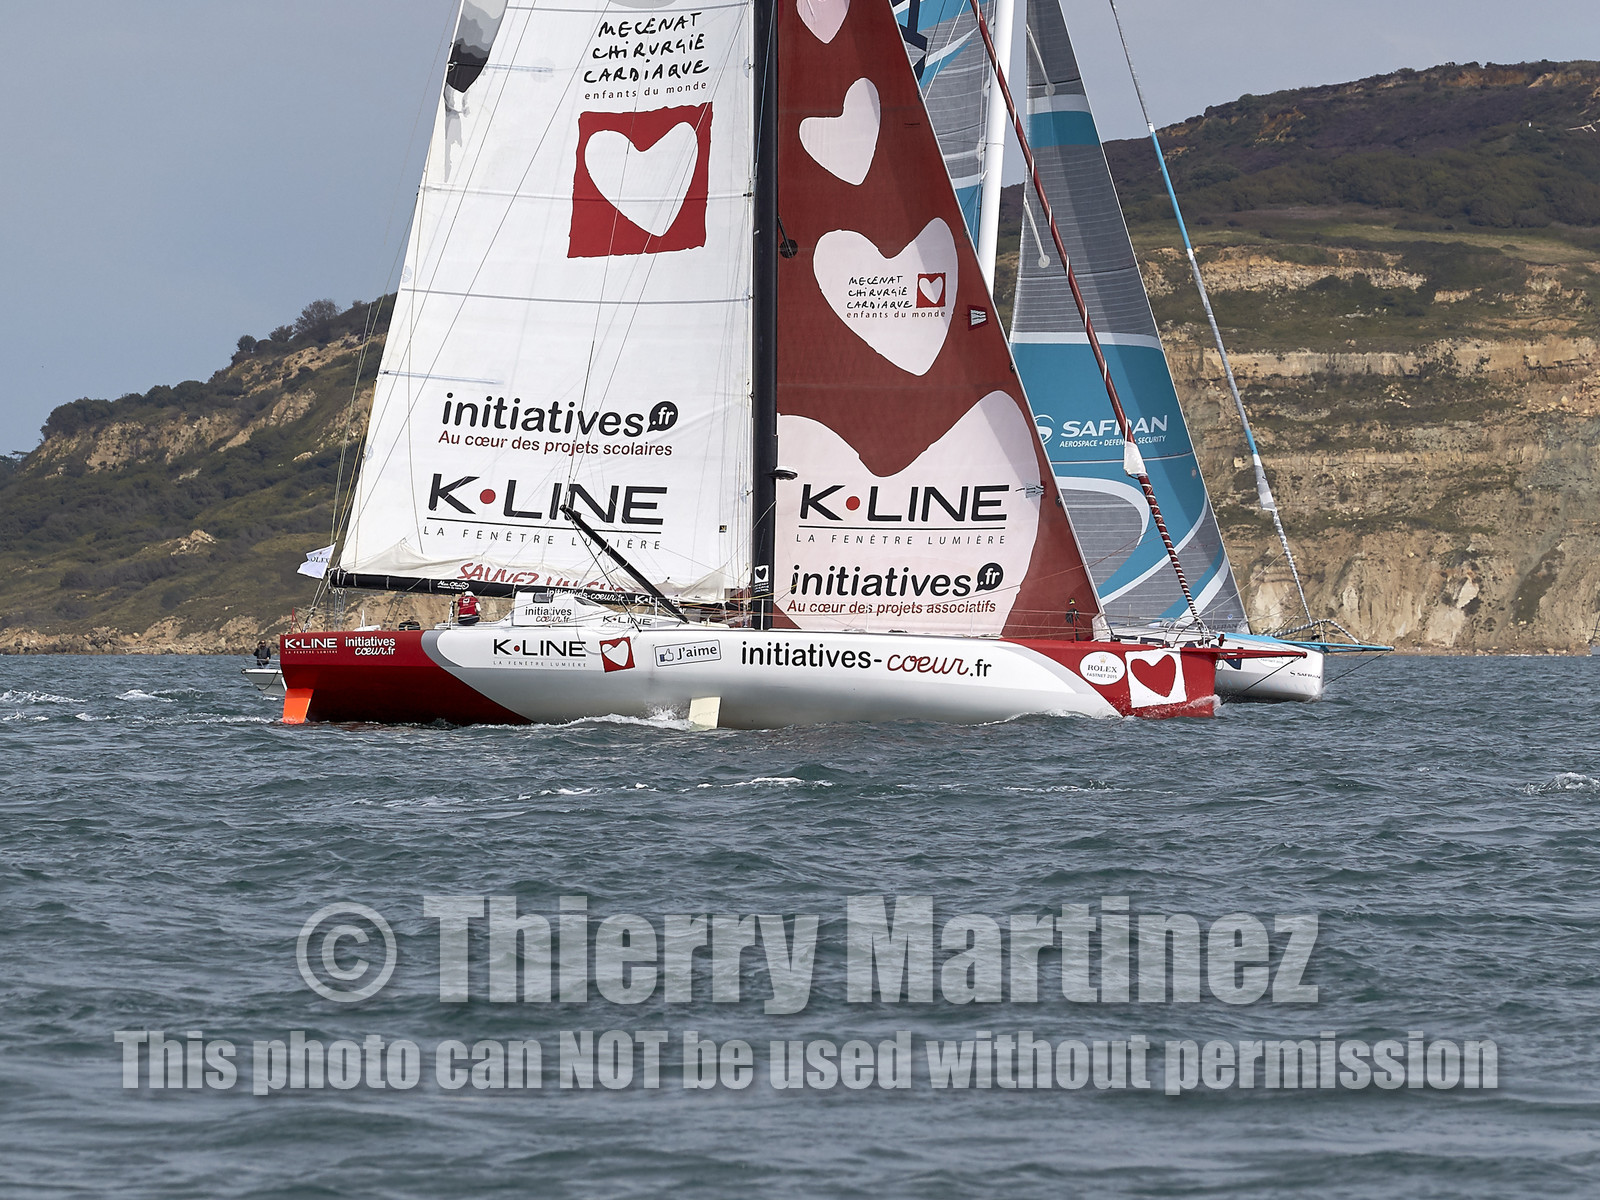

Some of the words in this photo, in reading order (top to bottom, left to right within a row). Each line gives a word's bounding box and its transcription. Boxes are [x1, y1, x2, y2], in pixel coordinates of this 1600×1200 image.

[599, 12, 702, 38] MECENAT
[585, 89, 637, 100] enfants
[644, 86, 659, 97] du
[666, 81, 707, 94] monde
[849, 275, 903, 286] MECENAT
[847, 311, 889, 319] enfants
[912, 310, 946, 318] monde
[438, 431, 461, 445] Au
[465, 435, 508, 449] cœur
[512, 437, 540, 451] des
[544, 440, 598, 456] projets
[603, 442, 673, 456] scolaires
[1059, 439, 1098, 448] AEROSPACE
[1138, 435, 1166, 445] SECURITY
[424, 526, 445, 538] LA
[463, 530, 554, 545] FENÊTRE
[571, 536, 661, 550] LUIÈRE
[796, 534, 815, 543] LA
[831, 532, 913, 545] FENÊTRE
[928, 533, 1005, 545] LUMIÈRE
[787, 600, 805, 613] Au
[849, 601, 873, 614] des
[876, 602, 923, 616] projets
[927, 601, 996, 613] associatifs
[345, 636, 396, 647] initiatives
[1087, 664, 1118, 673] ROLEX
